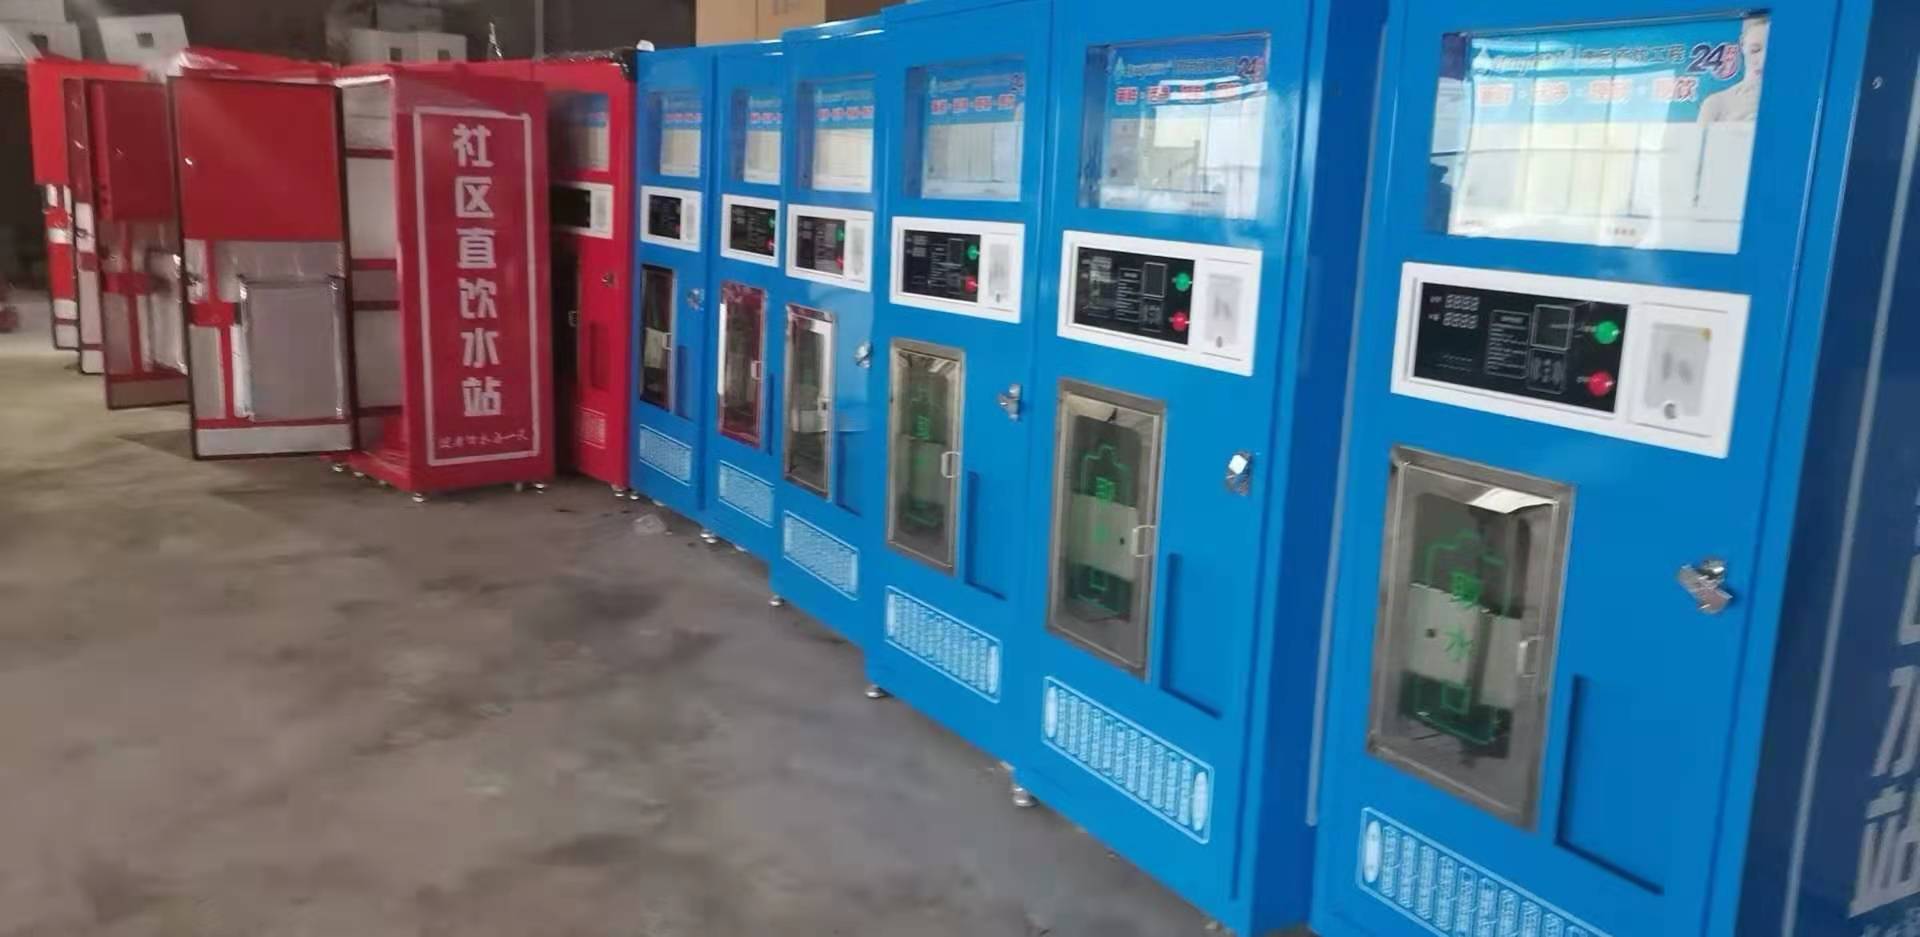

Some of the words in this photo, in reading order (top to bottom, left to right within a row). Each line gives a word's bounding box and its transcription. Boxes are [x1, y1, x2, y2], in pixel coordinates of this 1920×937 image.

[453, 124, 502, 416] 社区直饮水站
